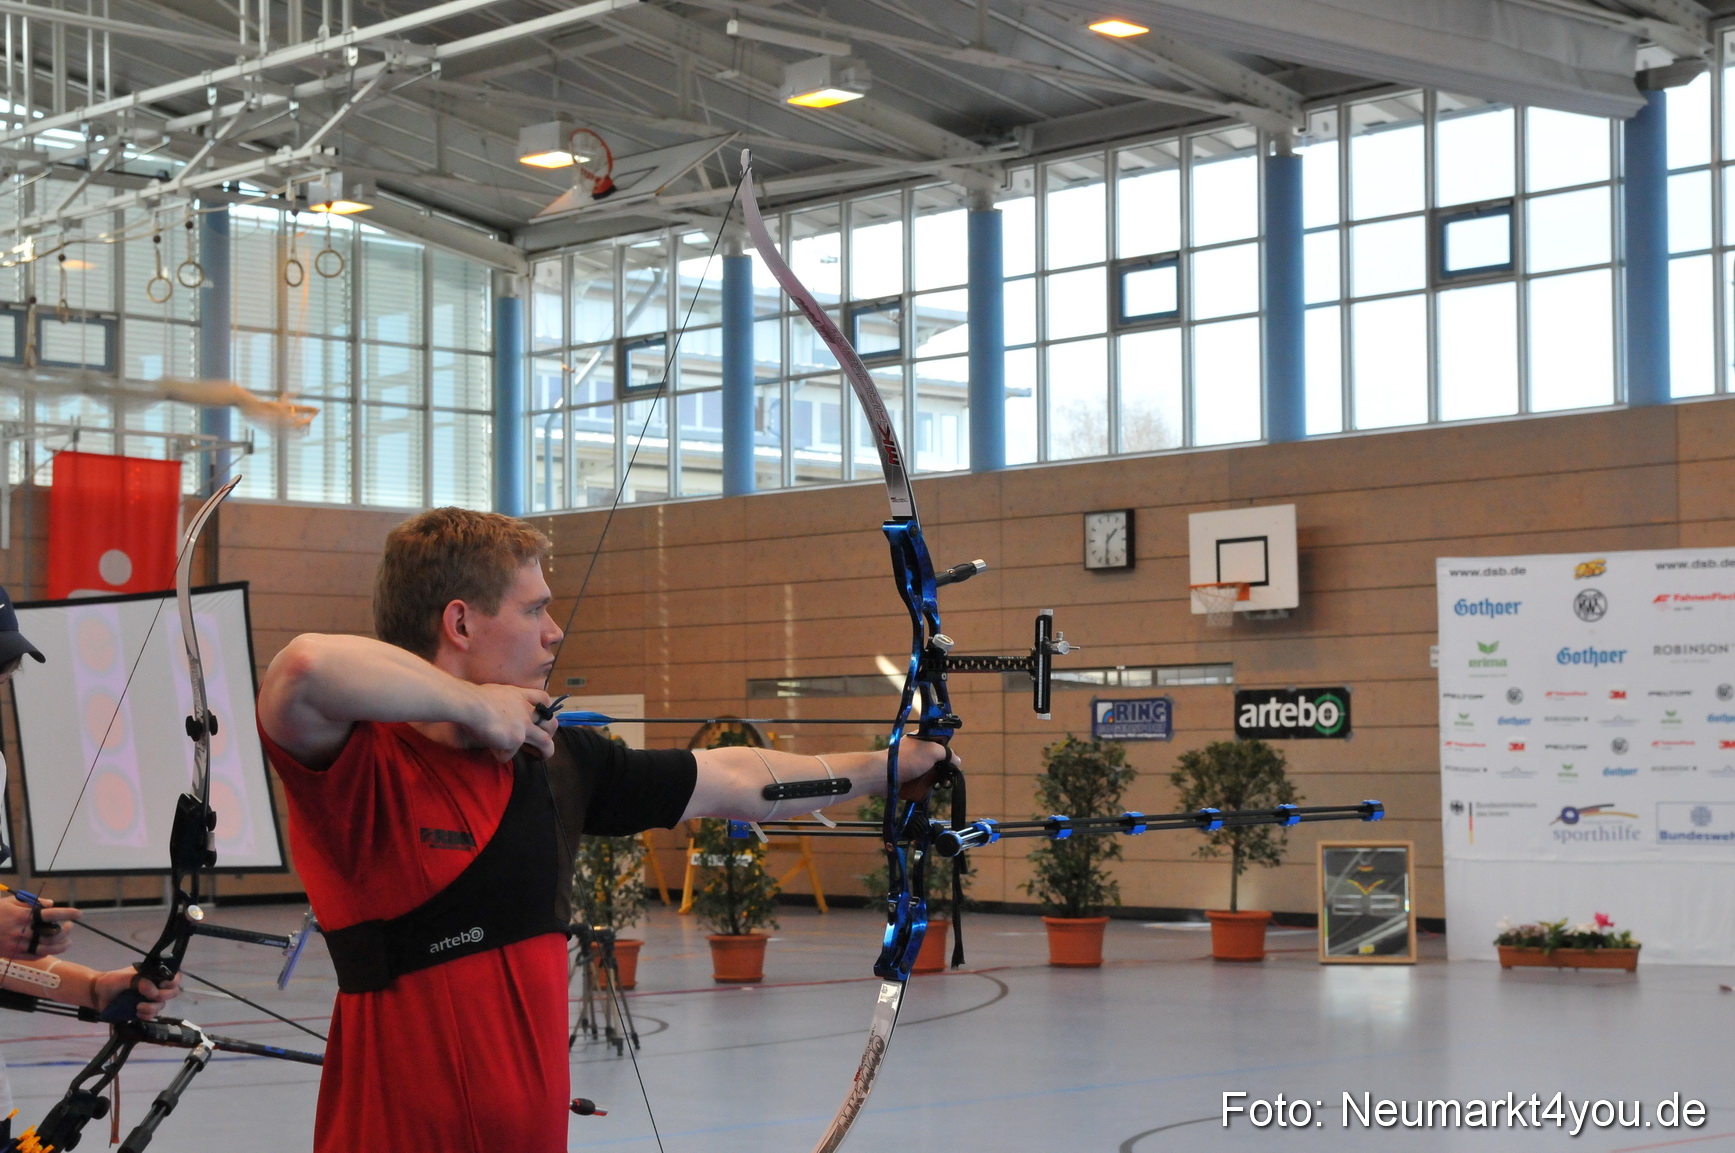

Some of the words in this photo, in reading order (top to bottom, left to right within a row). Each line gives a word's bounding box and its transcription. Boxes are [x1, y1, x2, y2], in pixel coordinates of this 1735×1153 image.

[1449, 566, 1527, 577] www.dsb.de
[1653, 644, 1729, 656] ROBINSON
[1114, 701, 1167, 723] RING
[1239, 695, 1340, 731] artebo
[1553, 825, 1641, 844] sporthilfe
[429, 927, 484, 954] artebo
